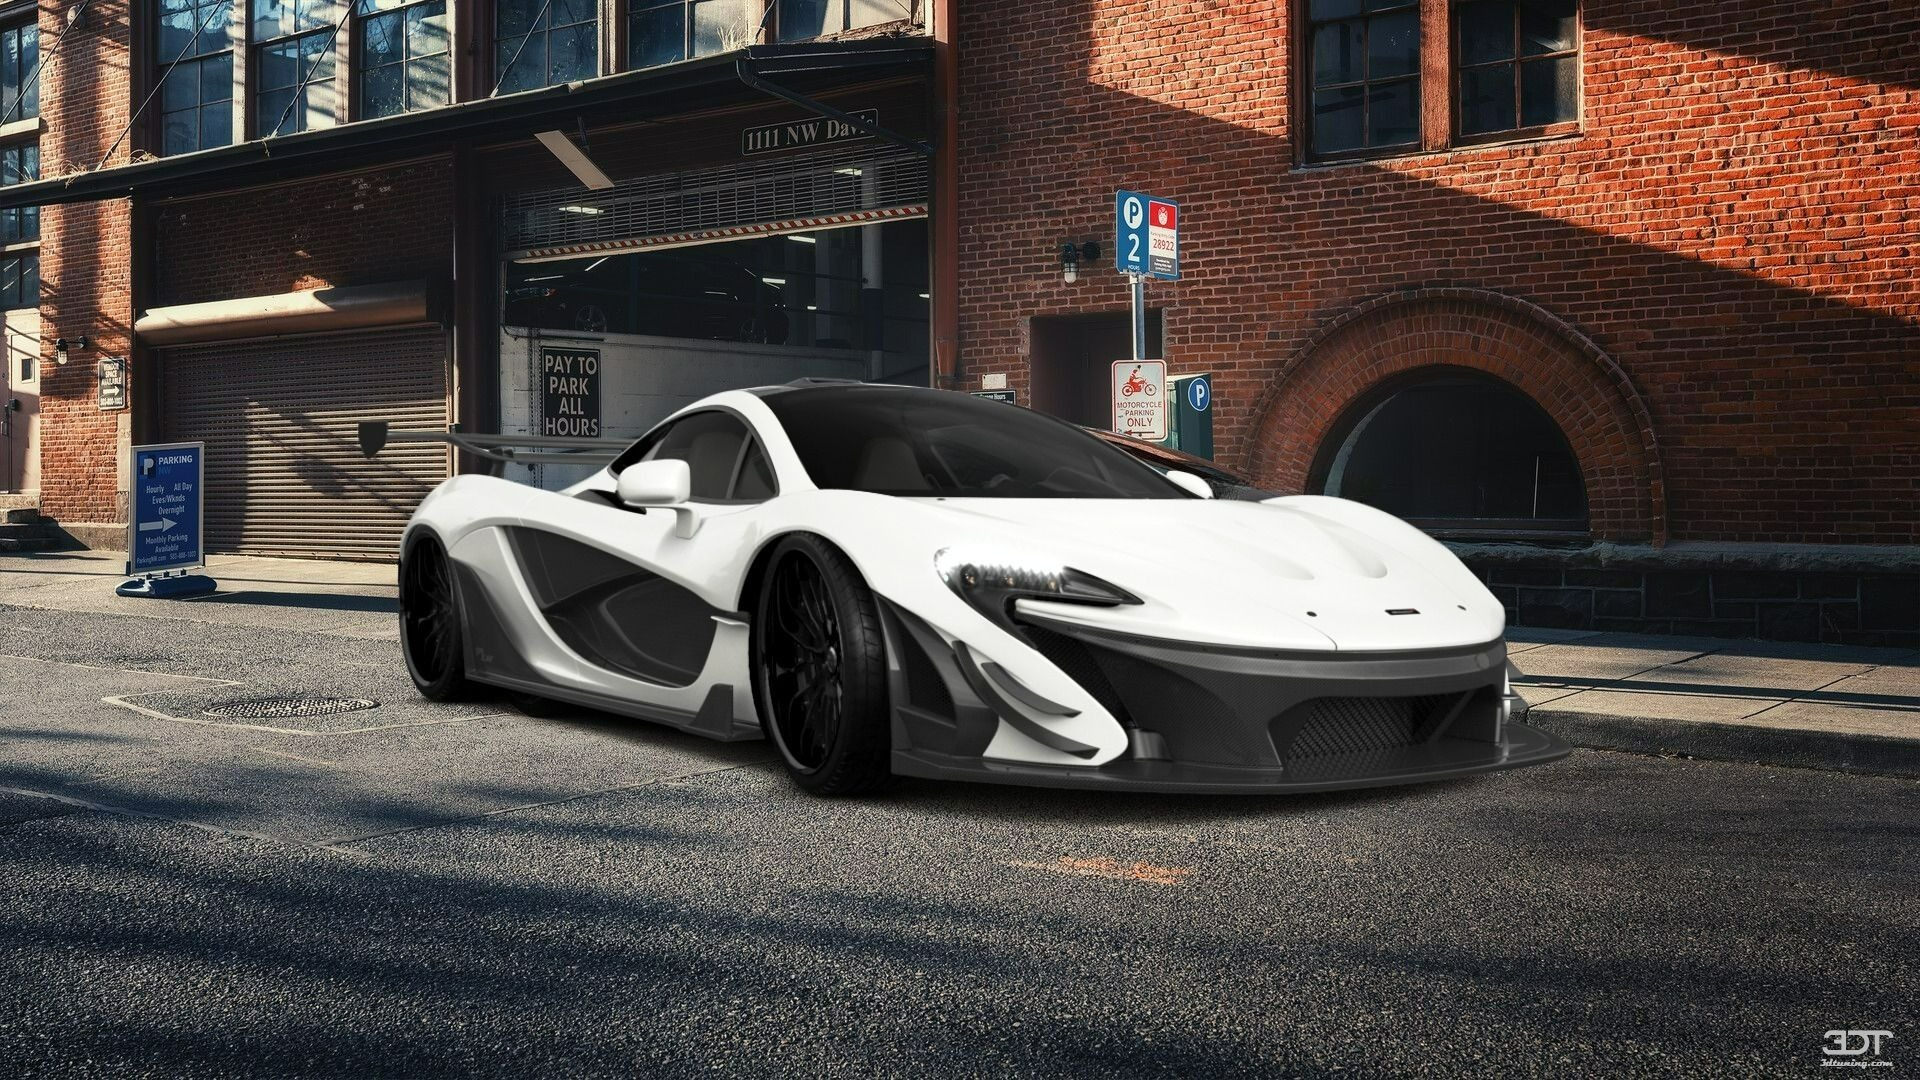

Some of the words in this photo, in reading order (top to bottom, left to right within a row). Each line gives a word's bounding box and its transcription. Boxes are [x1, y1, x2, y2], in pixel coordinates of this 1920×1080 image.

[747, 128, 780, 150] 1111
[786, 122, 820, 145] NW
[1129, 201, 1139, 224] P
[1127, 233, 1140, 262] 2
[1153, 238, 1175, 251] 28922
[545, 354, 573, 374] PAY
[577, 355, 598, 375] TO
[549, 376, 589, 395] PARK
[1196, 384, 1205, 407] P
[558, 396, 585, 415] ALL
[1117, 401, 1162, 409] MOTORCYCLE
[545, 416, 599, 436] HOURS
[1127, 417, 1153, 427] ONLY
[143, 458, 154, 475] P
[158, 454, 193, 465] PARKING
[146, 484, 165, 494] Hourly
[173, 483, 181, 491] All
[182, 482, 193, 492] Day
[158, 504, 185, 515] Overnight
[145, 535, 167, 545] Monthly
[167, 533, 188, 543] Parking
[155, 543, 179, 553] Available
